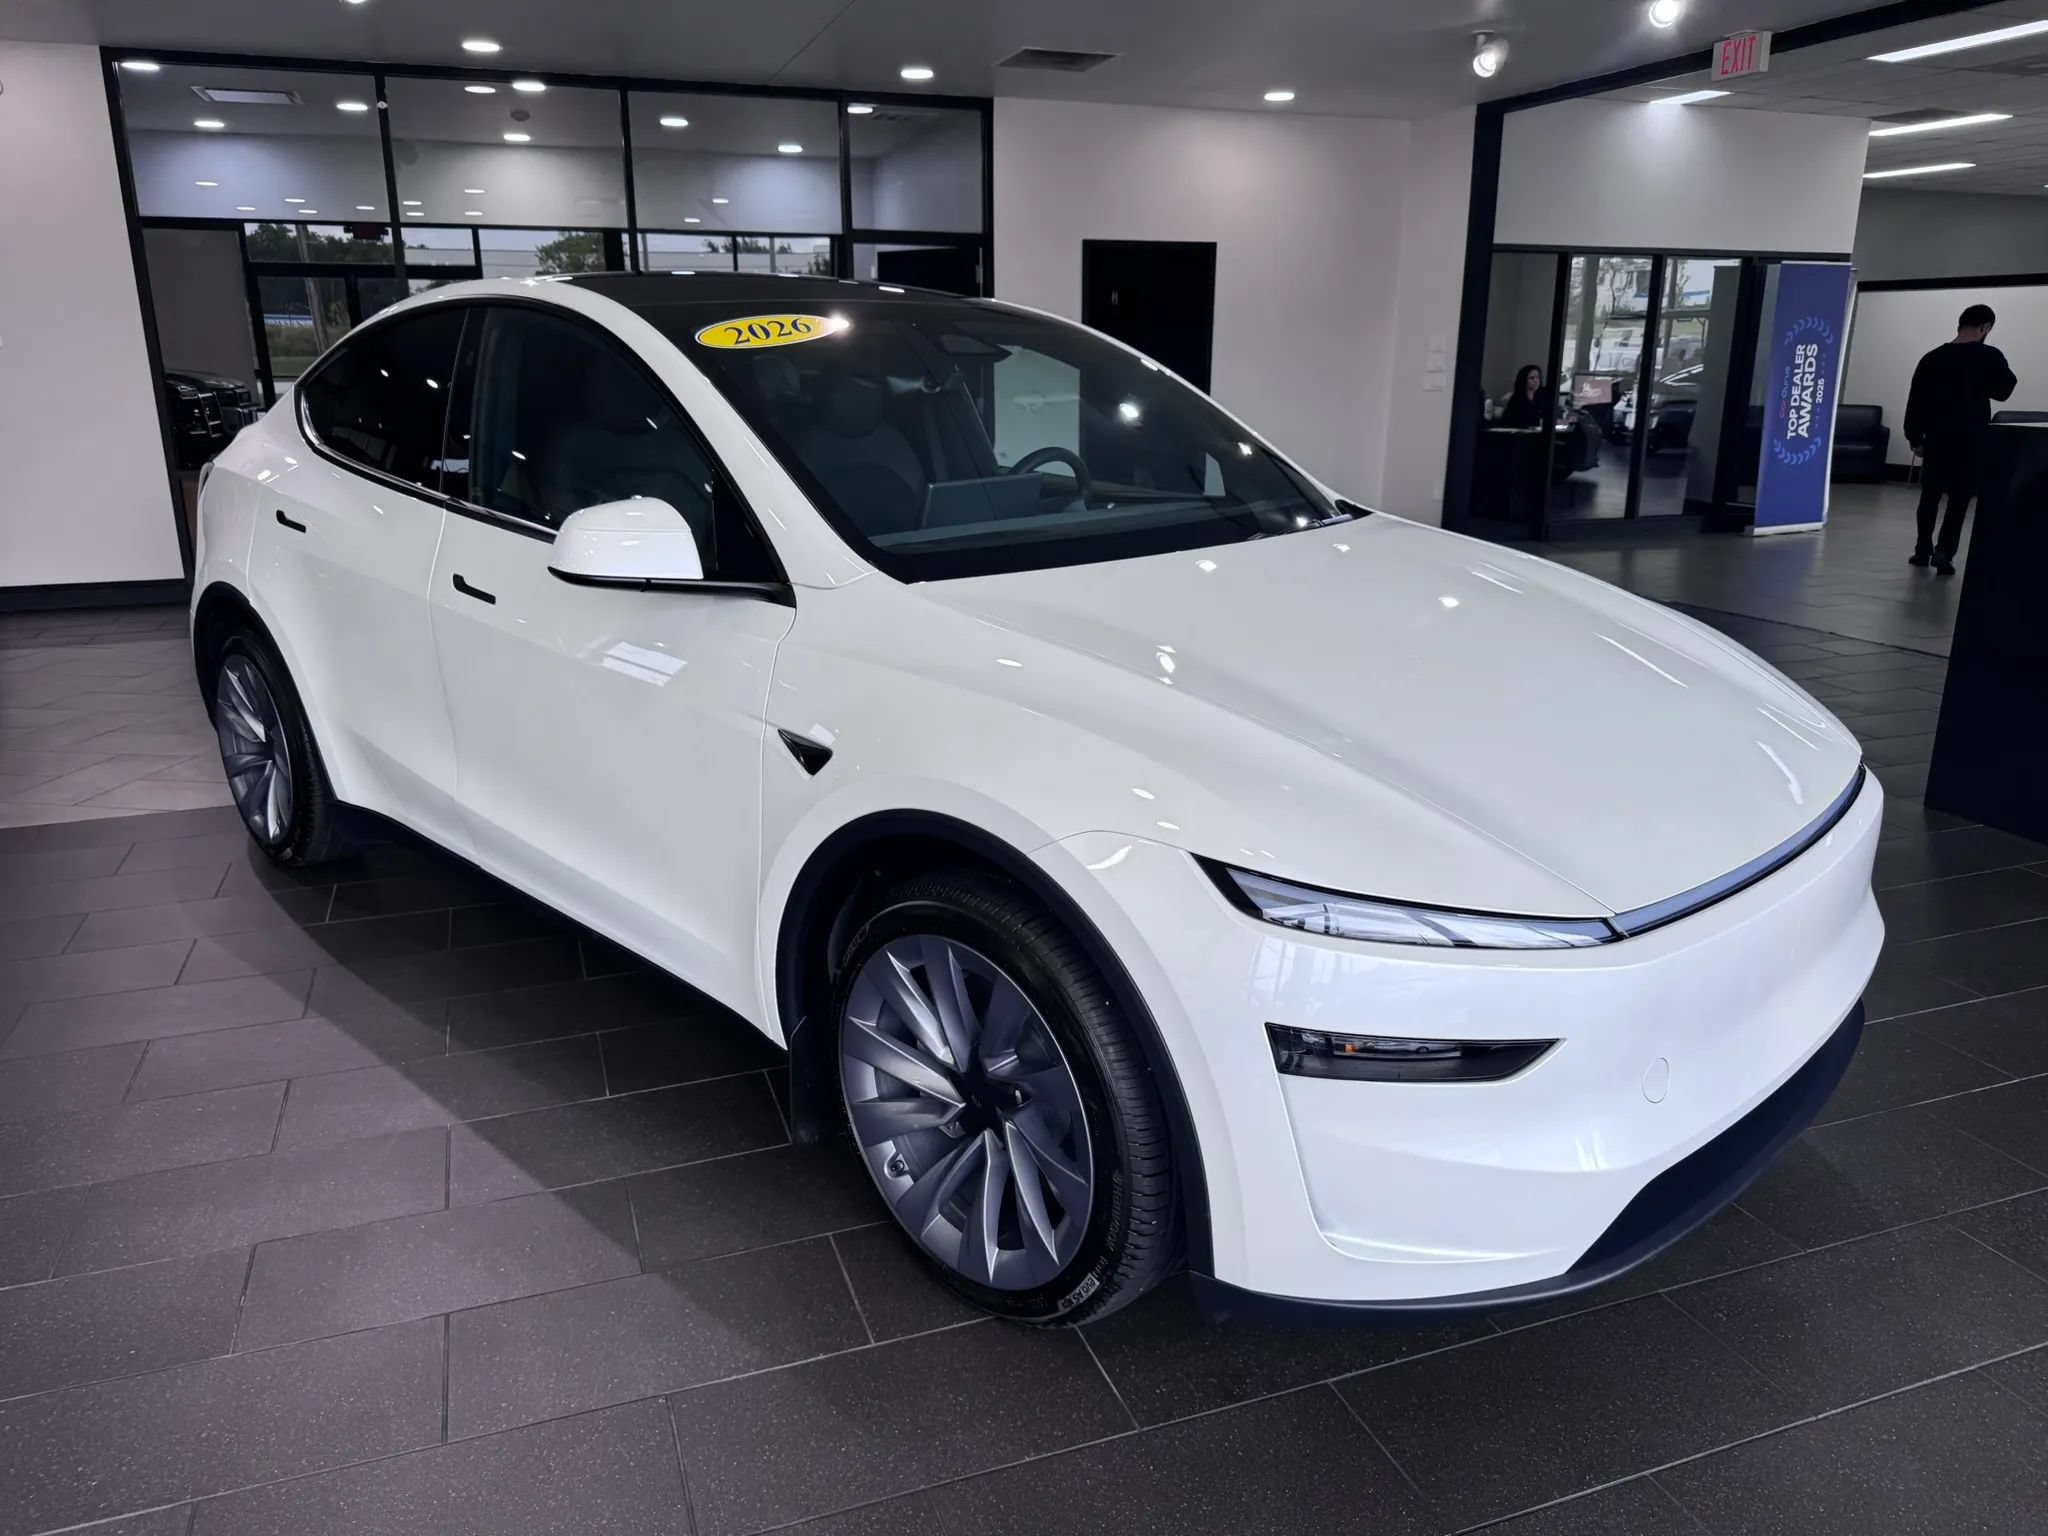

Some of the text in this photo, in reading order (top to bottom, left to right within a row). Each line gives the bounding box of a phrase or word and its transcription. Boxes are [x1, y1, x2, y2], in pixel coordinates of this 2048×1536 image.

[1721, 35, 1756, 75] EXIT
[724, 317, 813, 346] 2026
[1786, 344, 1806, 440] TOP DEALER
[1797, 343, 1818, 438] AWARDS
